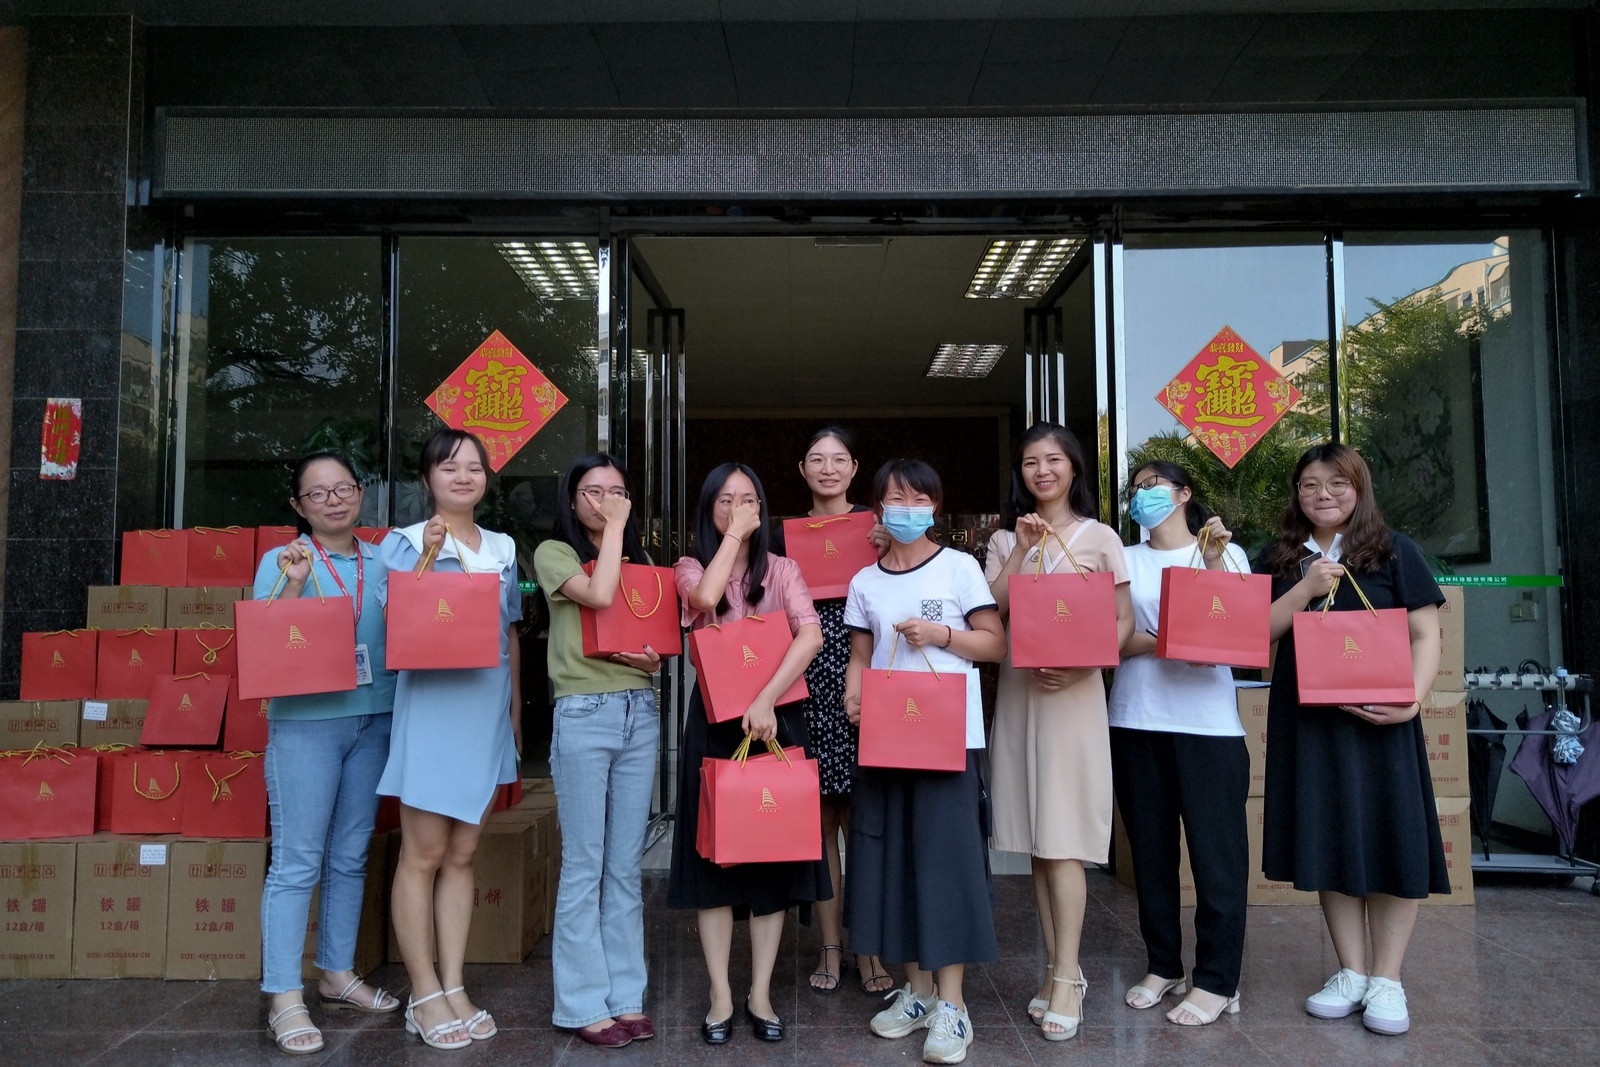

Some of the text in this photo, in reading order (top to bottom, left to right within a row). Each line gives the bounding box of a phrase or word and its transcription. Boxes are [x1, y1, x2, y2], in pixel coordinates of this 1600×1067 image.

[6, 922, 45, 932] 12盒/箱
[101, 921, 140, 931] 12盒/箱
[195, 922, 234, 932] 12盒/箱
